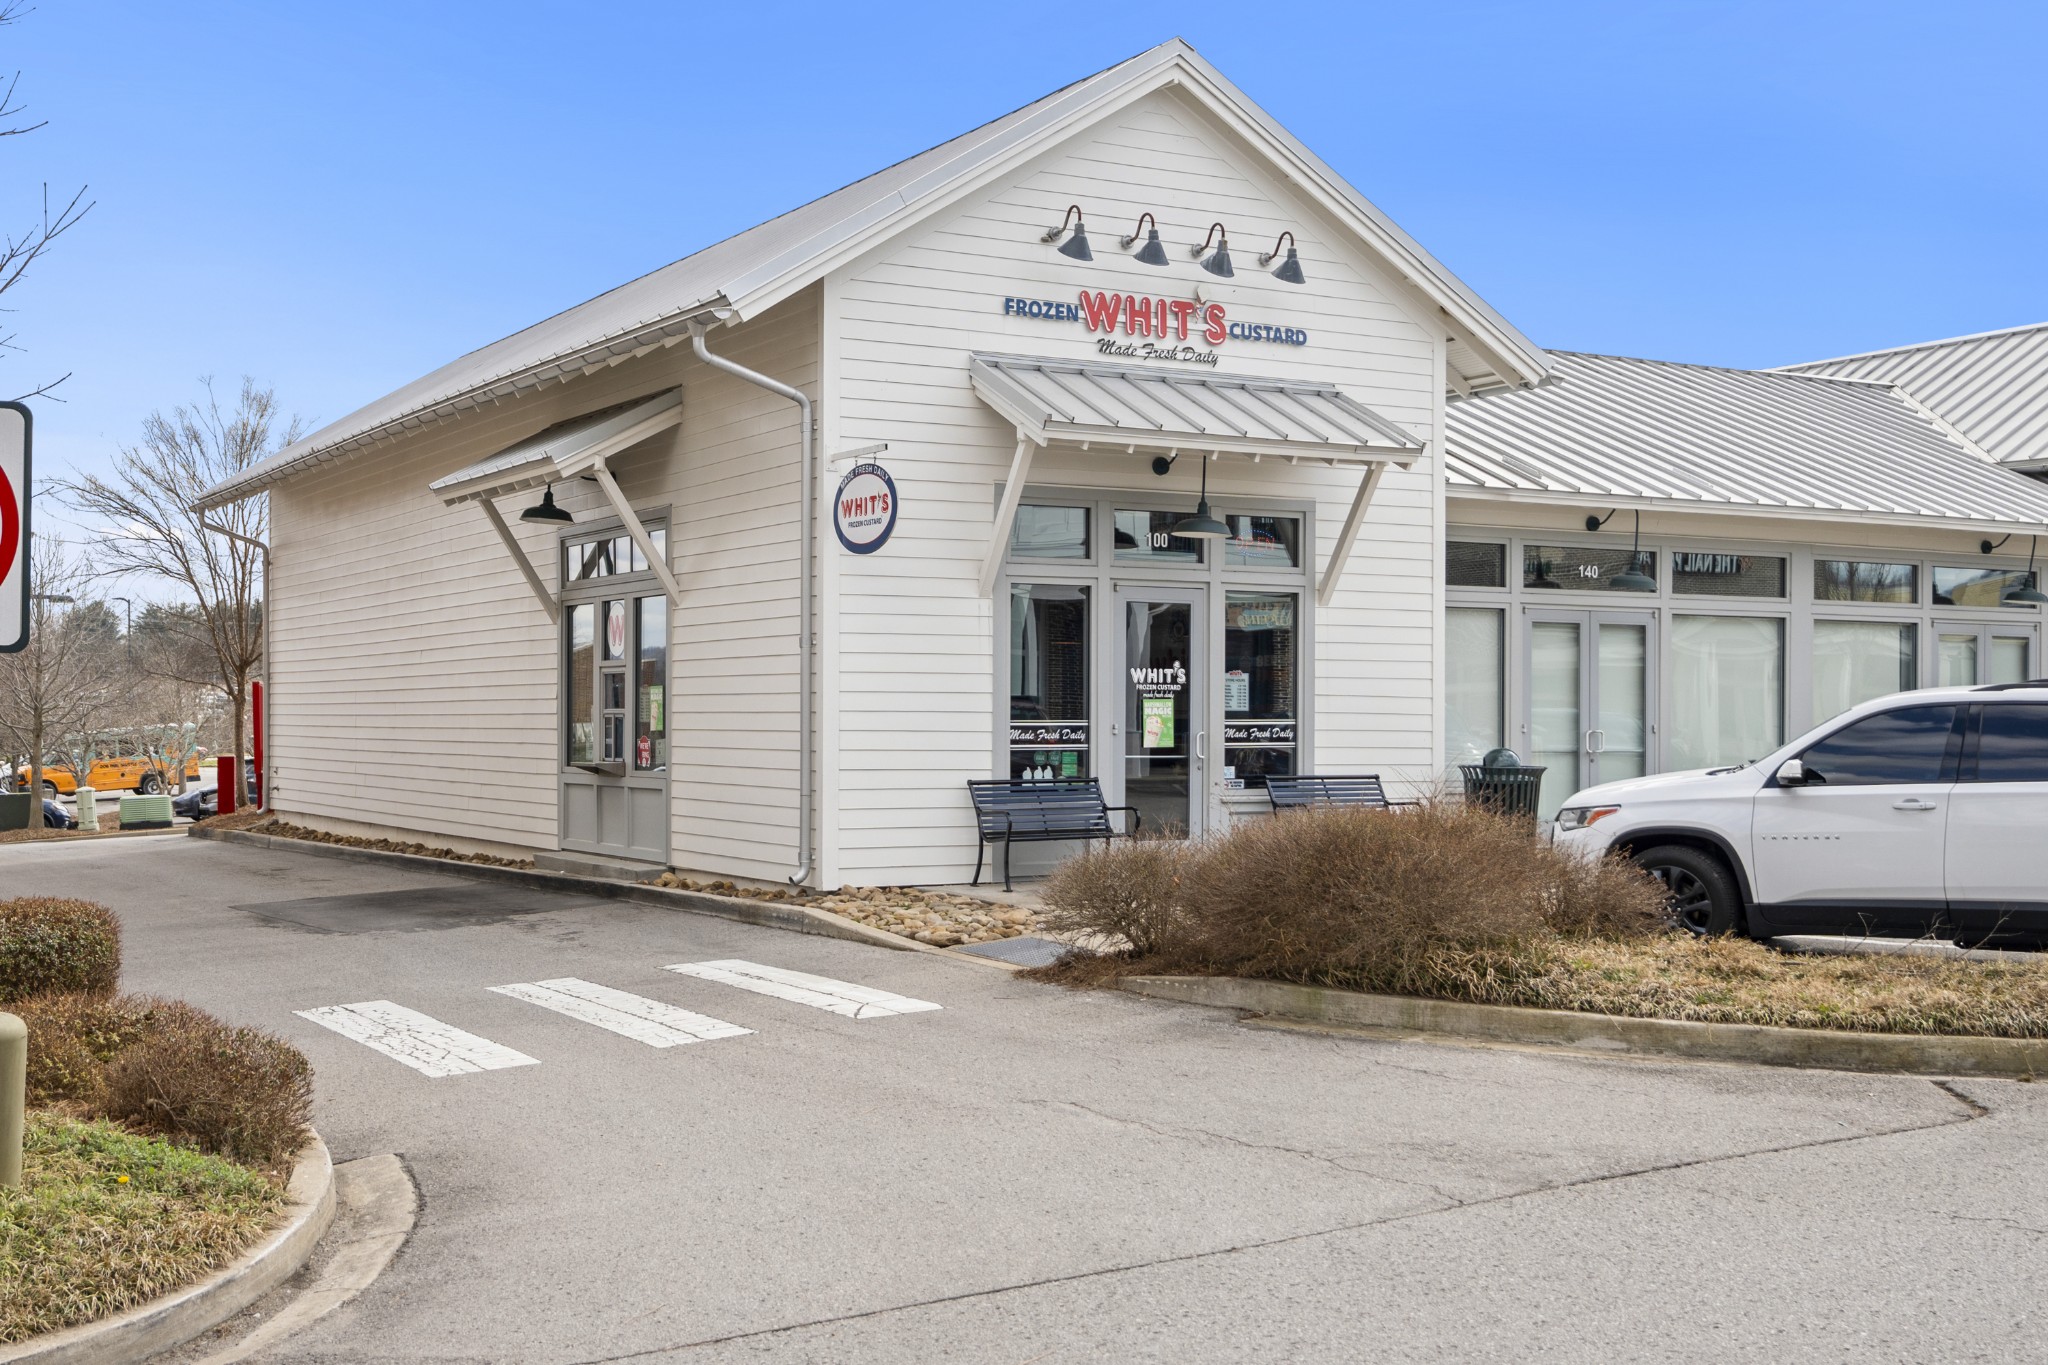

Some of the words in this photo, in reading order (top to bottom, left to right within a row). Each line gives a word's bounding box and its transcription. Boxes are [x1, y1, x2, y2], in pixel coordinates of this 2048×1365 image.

[1005, 297, 1079, 322] FROZEN
[1080, 285, 1227, 346] WHIT'S
[1229, 322, 1307, 346] CUSTARD
[1097, 338, 1137, 356] Made
[1142, 343, 1178, 360] Fresh
[1182, 347, 1219, 368] Daily
[840, 470, 854, 489] MADE
[855, 465, 873, 475] FRESH
[874, 466, 889, 481] DAILY
[841, 491, 889, 519] WHIT'S
[848, 520, 863, 528] FROZEN
[864, 518, 882, 527] CUSTARD
[1145, 532, 1168, 548] 100
[1236, 535, 1275, 551] OPEN
[1579, 564, 1598, 578] 140
[1129, 660, 1186, 684] WHIT'S
[1009, 729, 1034, 739] Made
[1036, 729, 1060, 741] Fresh
[1062, 729, 1086, 741] Daily
[1224, 727, 1248, 738] Made
[1249, 727, 1271, 740] Fresh
[1272, 727, 1294, 740] Daily
